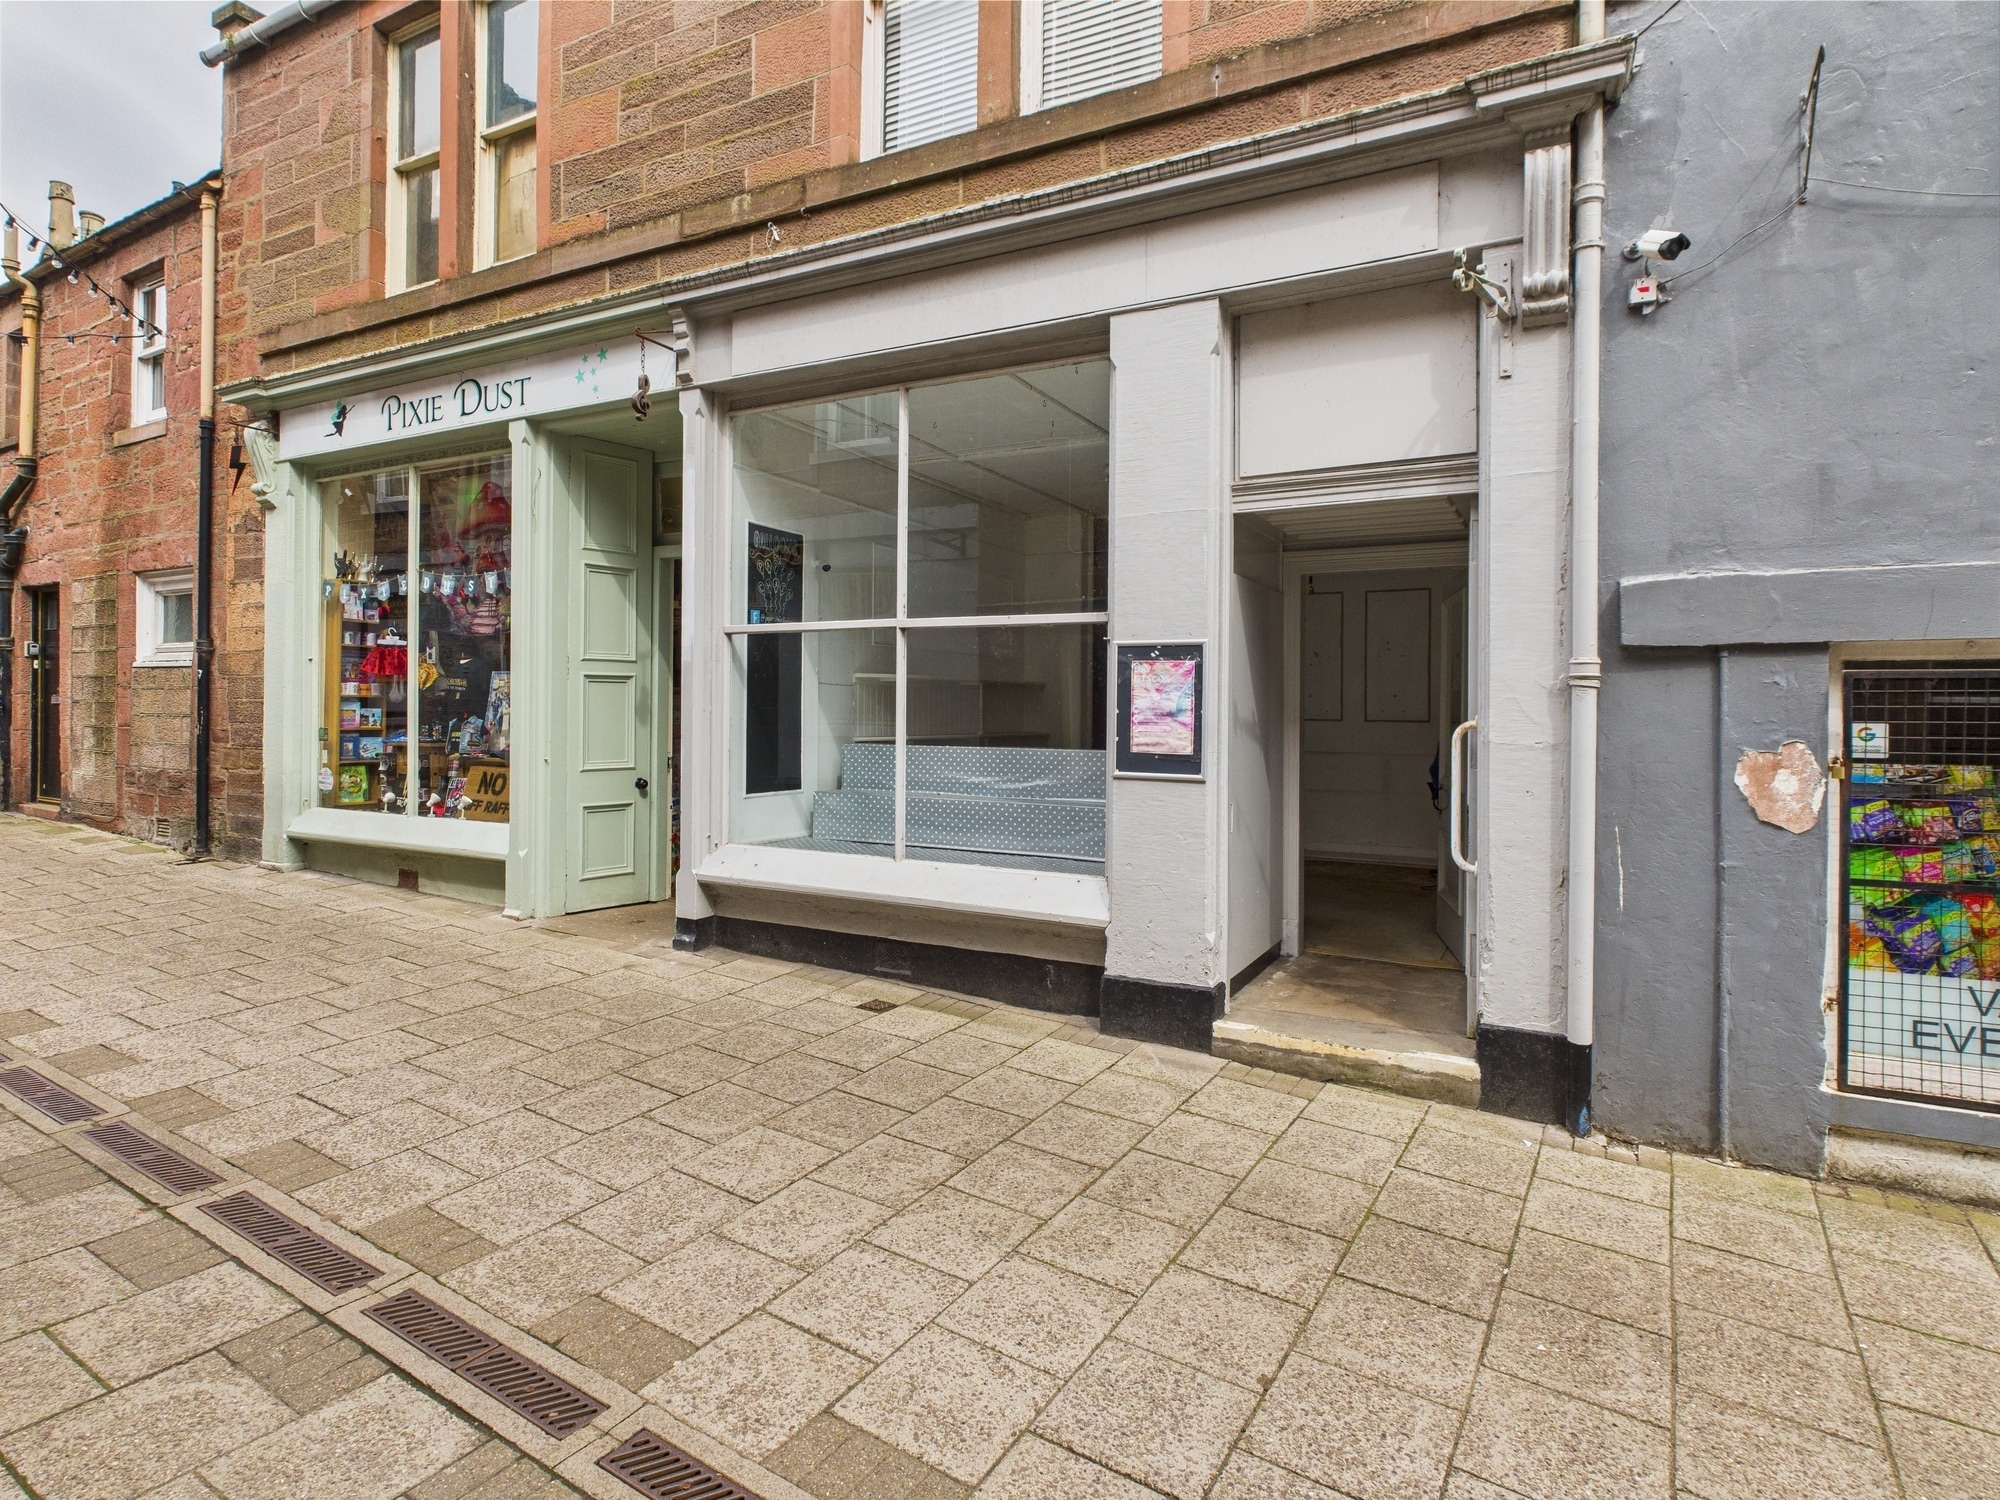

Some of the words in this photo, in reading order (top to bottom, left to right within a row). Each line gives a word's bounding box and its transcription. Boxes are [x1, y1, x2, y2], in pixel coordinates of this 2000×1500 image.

[381, 395, 444, 431] PIXIE
[453, 376, 532, 417] DUST
[476, 771, 508, 796] NO
[464, 799, 484, 812] IFF
[1967, 986, 2000, 1018] V
[1912, 1020, 2000, 1058] EVE
